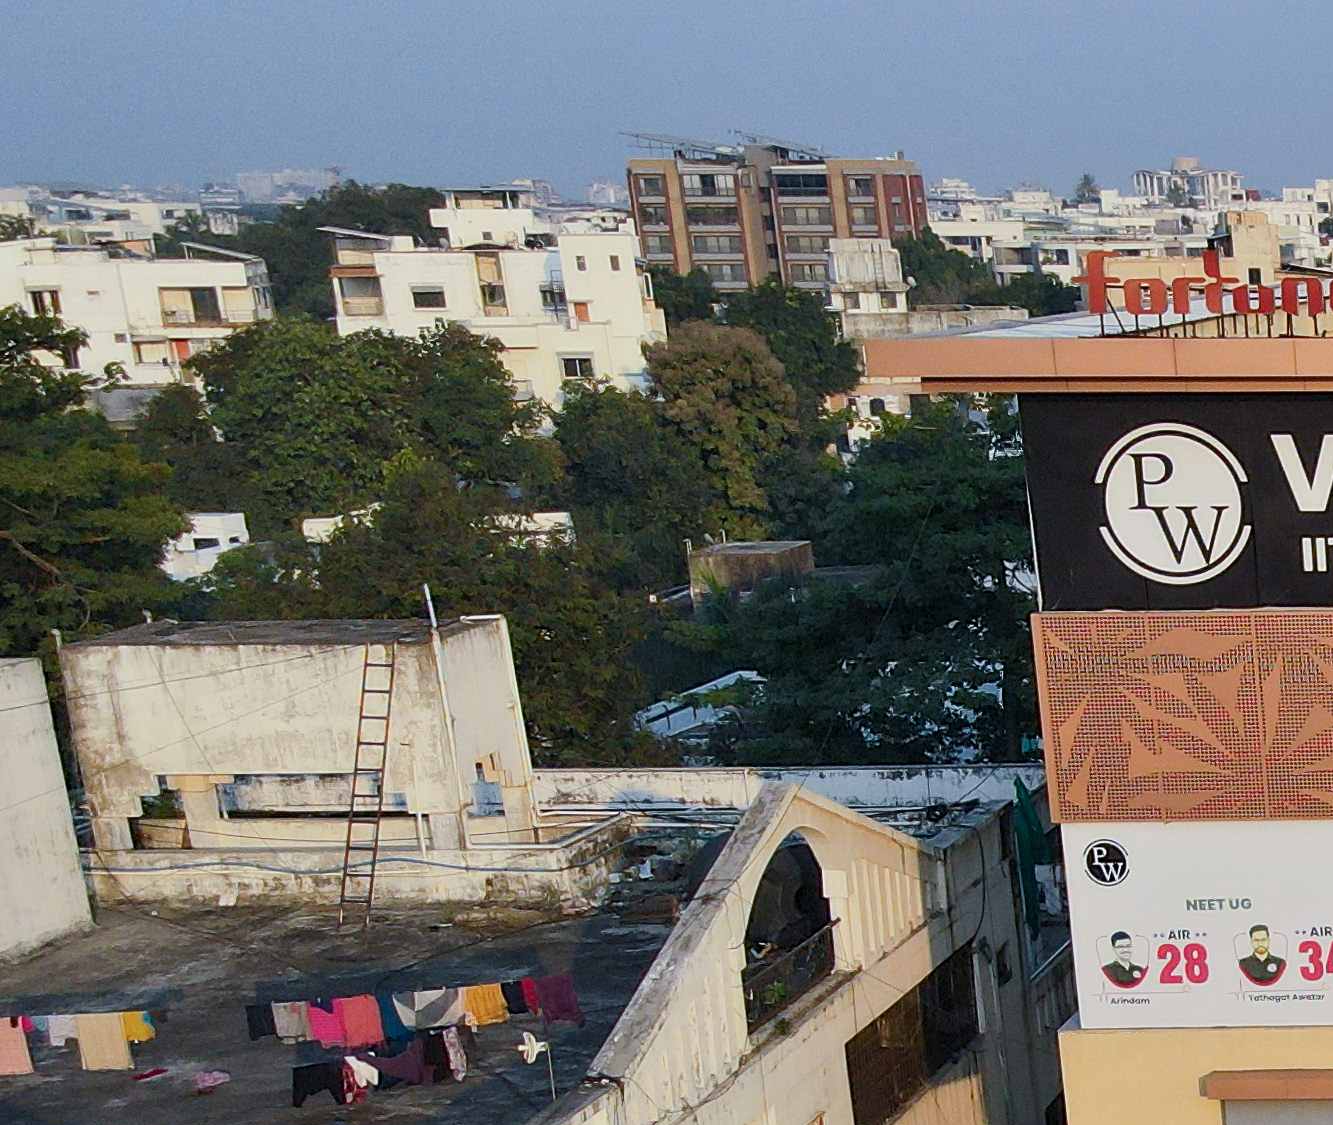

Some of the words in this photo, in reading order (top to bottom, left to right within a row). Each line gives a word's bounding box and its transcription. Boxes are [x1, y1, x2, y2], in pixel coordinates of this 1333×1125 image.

[1186, 899, 1226, 912] NEET
[1229, 898, 1252, 910] UG
[1168, 929, 1191, 940] AIR
[1310, 926, 1333, 937] AIR
[1157, 943, 1209, 984] 28
